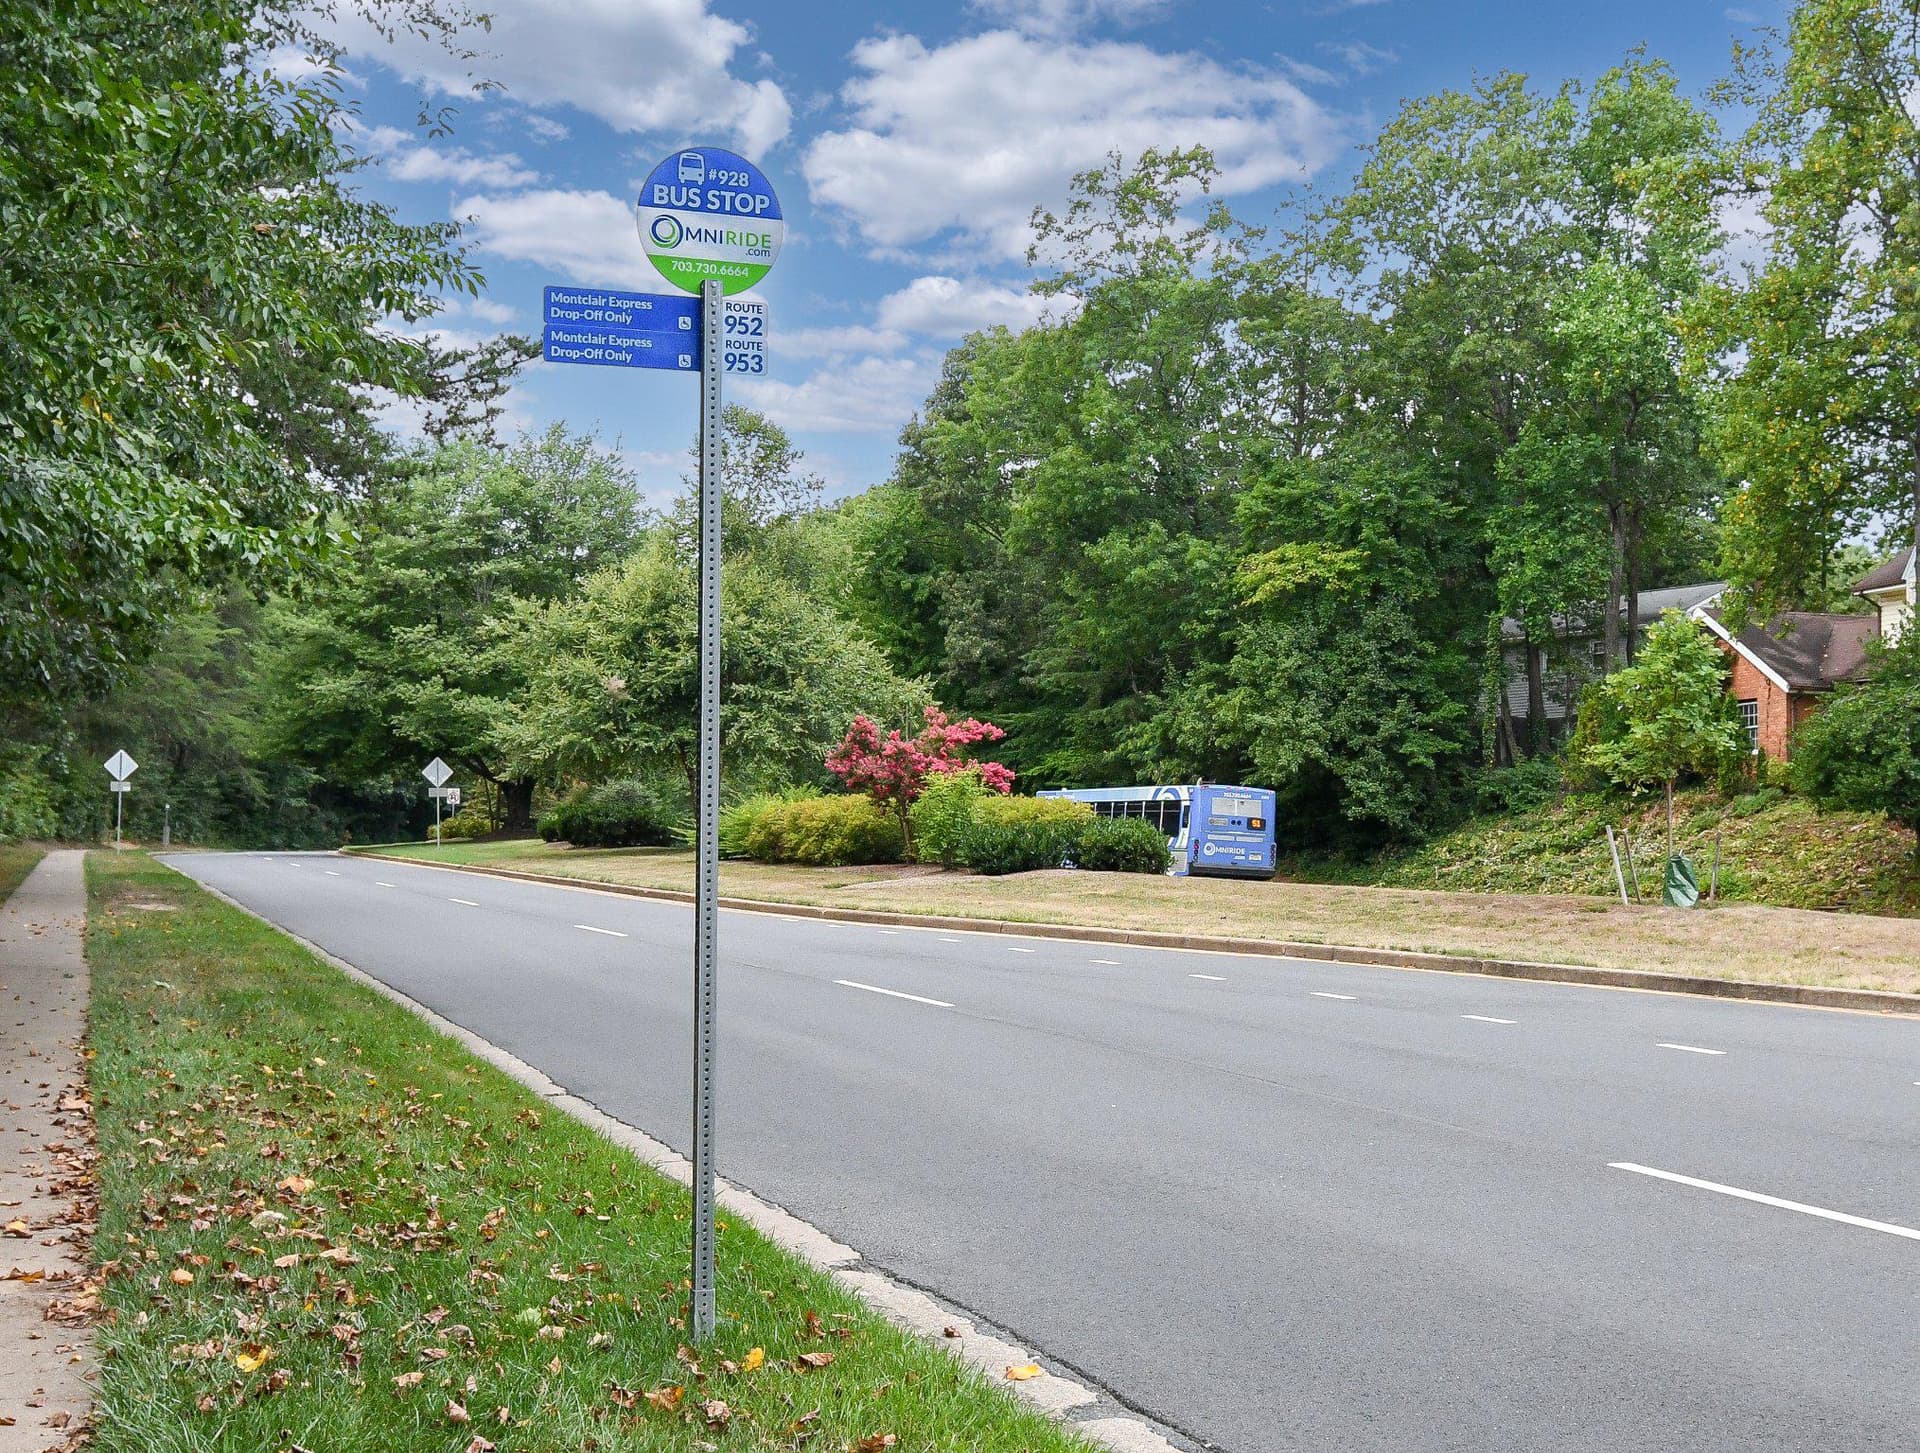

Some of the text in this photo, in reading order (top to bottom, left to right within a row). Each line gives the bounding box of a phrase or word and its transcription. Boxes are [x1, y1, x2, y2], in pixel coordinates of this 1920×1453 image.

[708, 168, 749, 187] #928
[653, 184, 770, 214] BUS STOP
[672, 260, 749, 277] 703.730.6664
[551, 292, 652, 310] Montclair Express
[725, 302, 763, 314] ROUTE
[551, 307, 632, 325] Drop-Off Only
[724, 315, 763, 336] 952
[551, 331, 652, 348] Montclair Express
[725, 340, 763, 351] ROUTE
[551, 346, 632, 363] Drop-Off Only
[724, 353, 763, 373] 953
